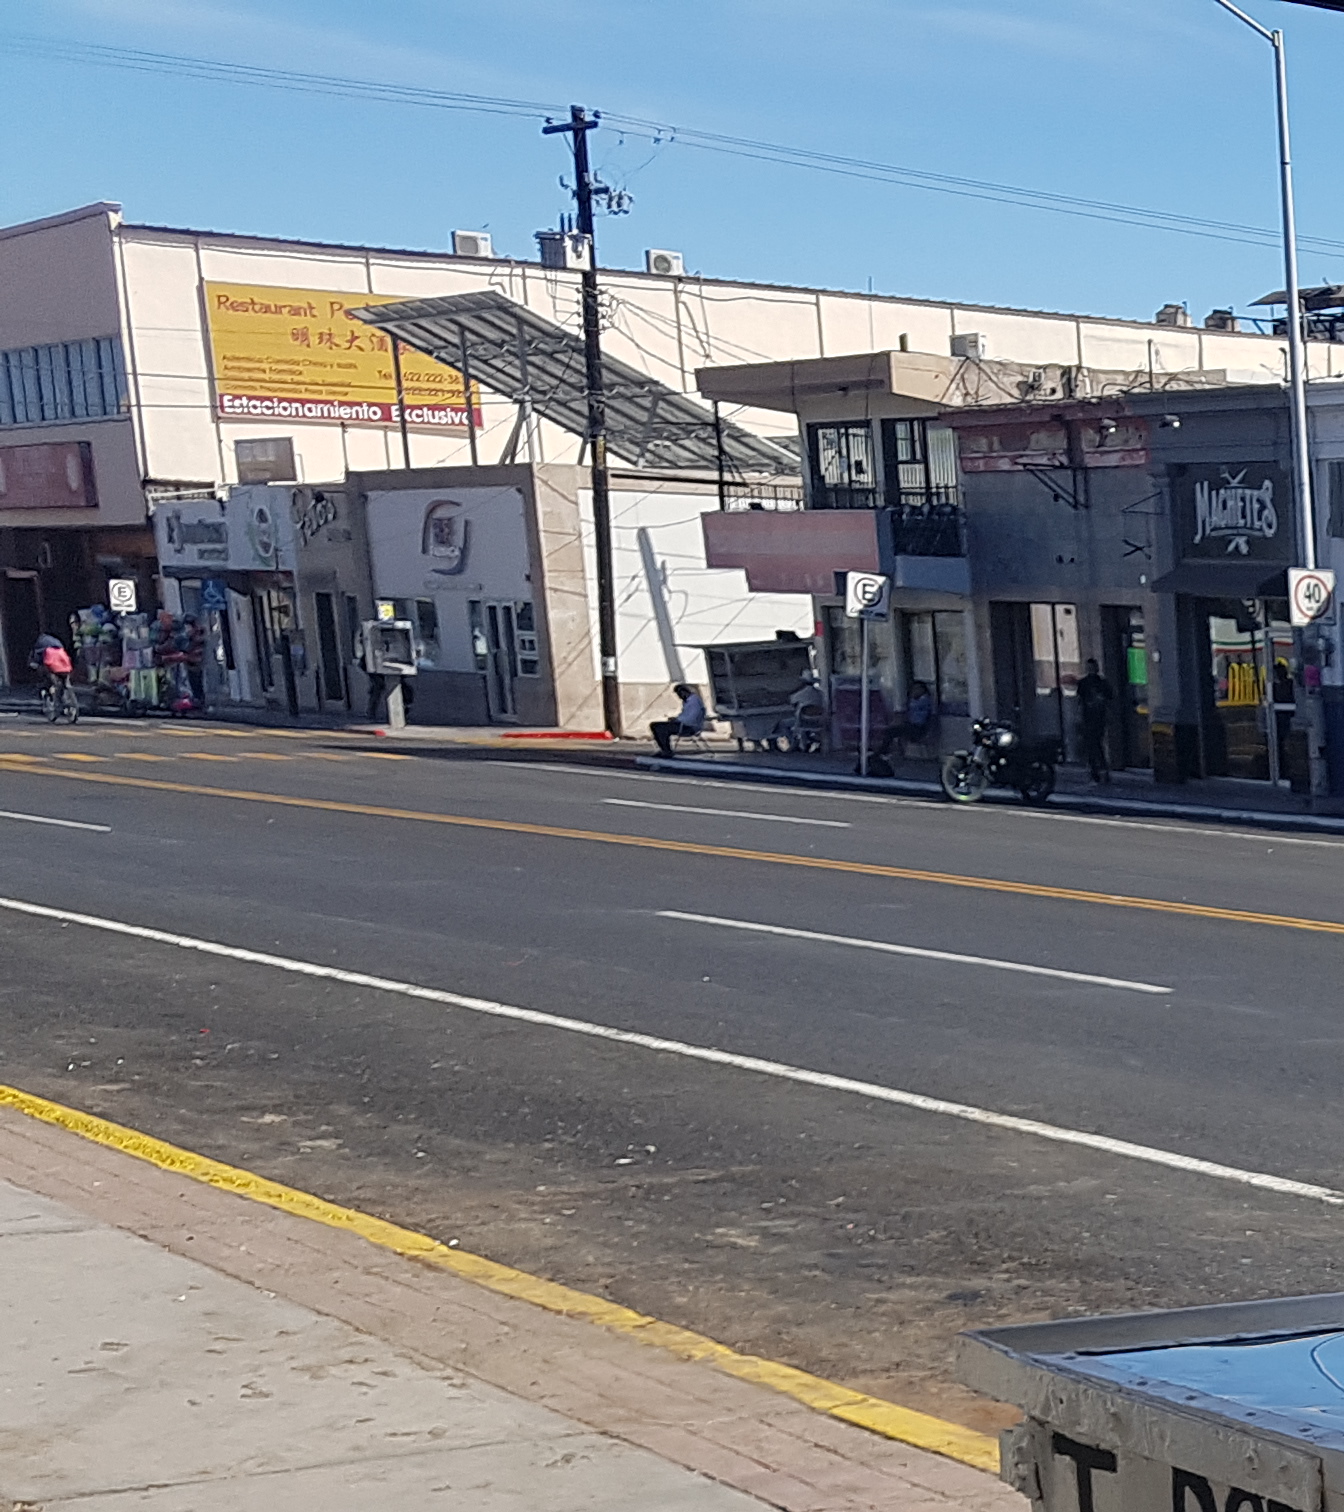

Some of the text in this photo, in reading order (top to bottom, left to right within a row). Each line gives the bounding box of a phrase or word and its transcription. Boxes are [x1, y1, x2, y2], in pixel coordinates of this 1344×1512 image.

[215, 294, 318, 319] Restaurant
[221, 394, 382, 421] Estacionamiento
[117, 586, 127, 598] E
[862, 583, 876, 602] E
[1304, 582, 1321, 603] 40
